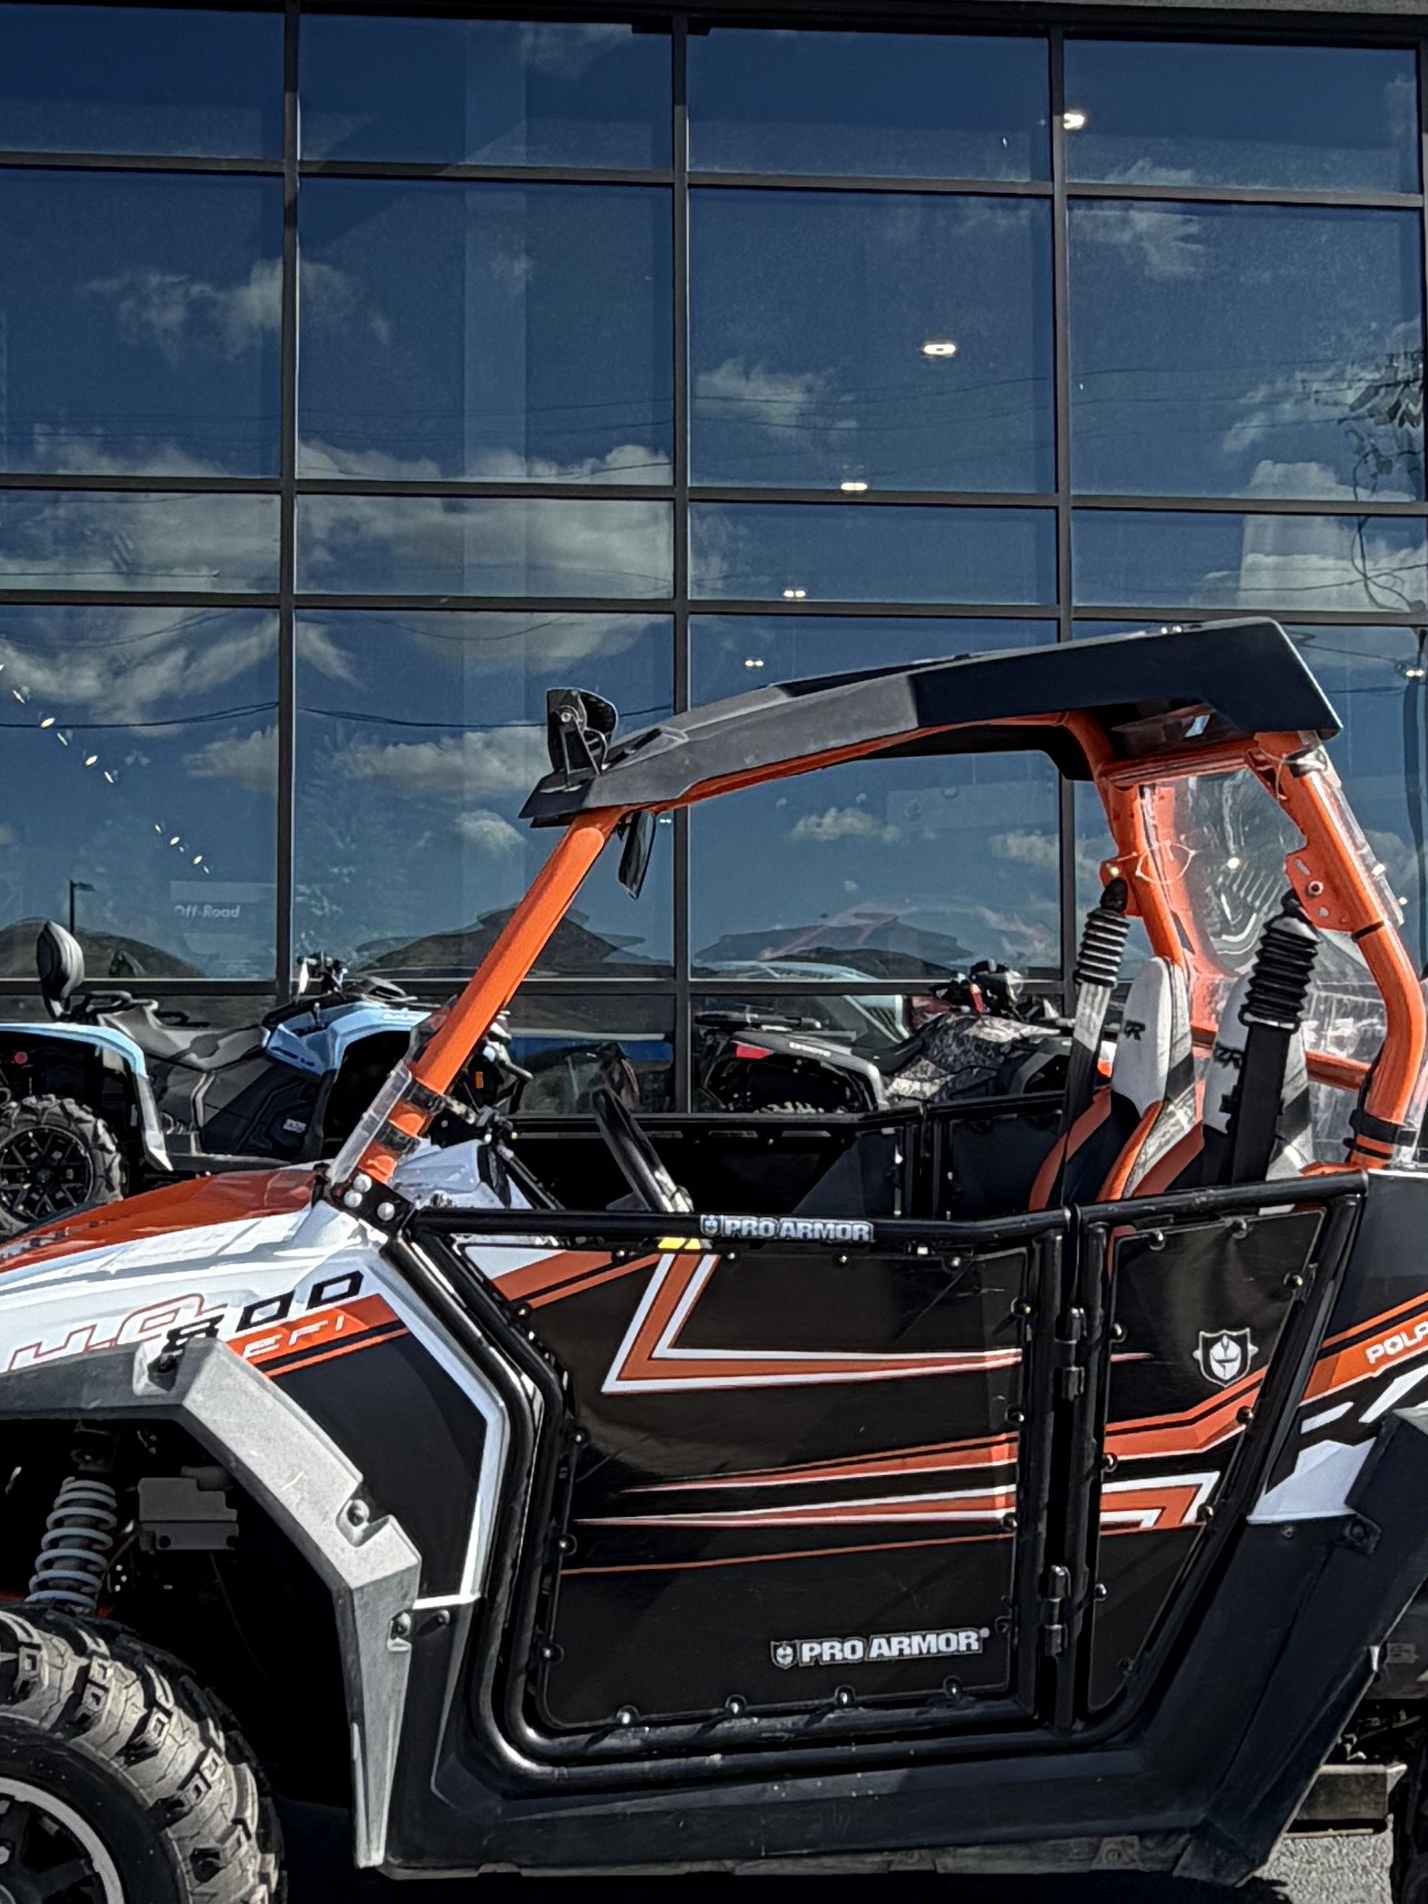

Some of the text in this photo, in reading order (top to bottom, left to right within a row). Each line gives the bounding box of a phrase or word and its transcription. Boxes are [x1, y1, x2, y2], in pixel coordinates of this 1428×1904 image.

[724, 1219, 871, 1242] PRO ARMOR
[243, 1315, 345, 1359] EFI
[801, 1630, 980, 1663] PRO ARMOR
